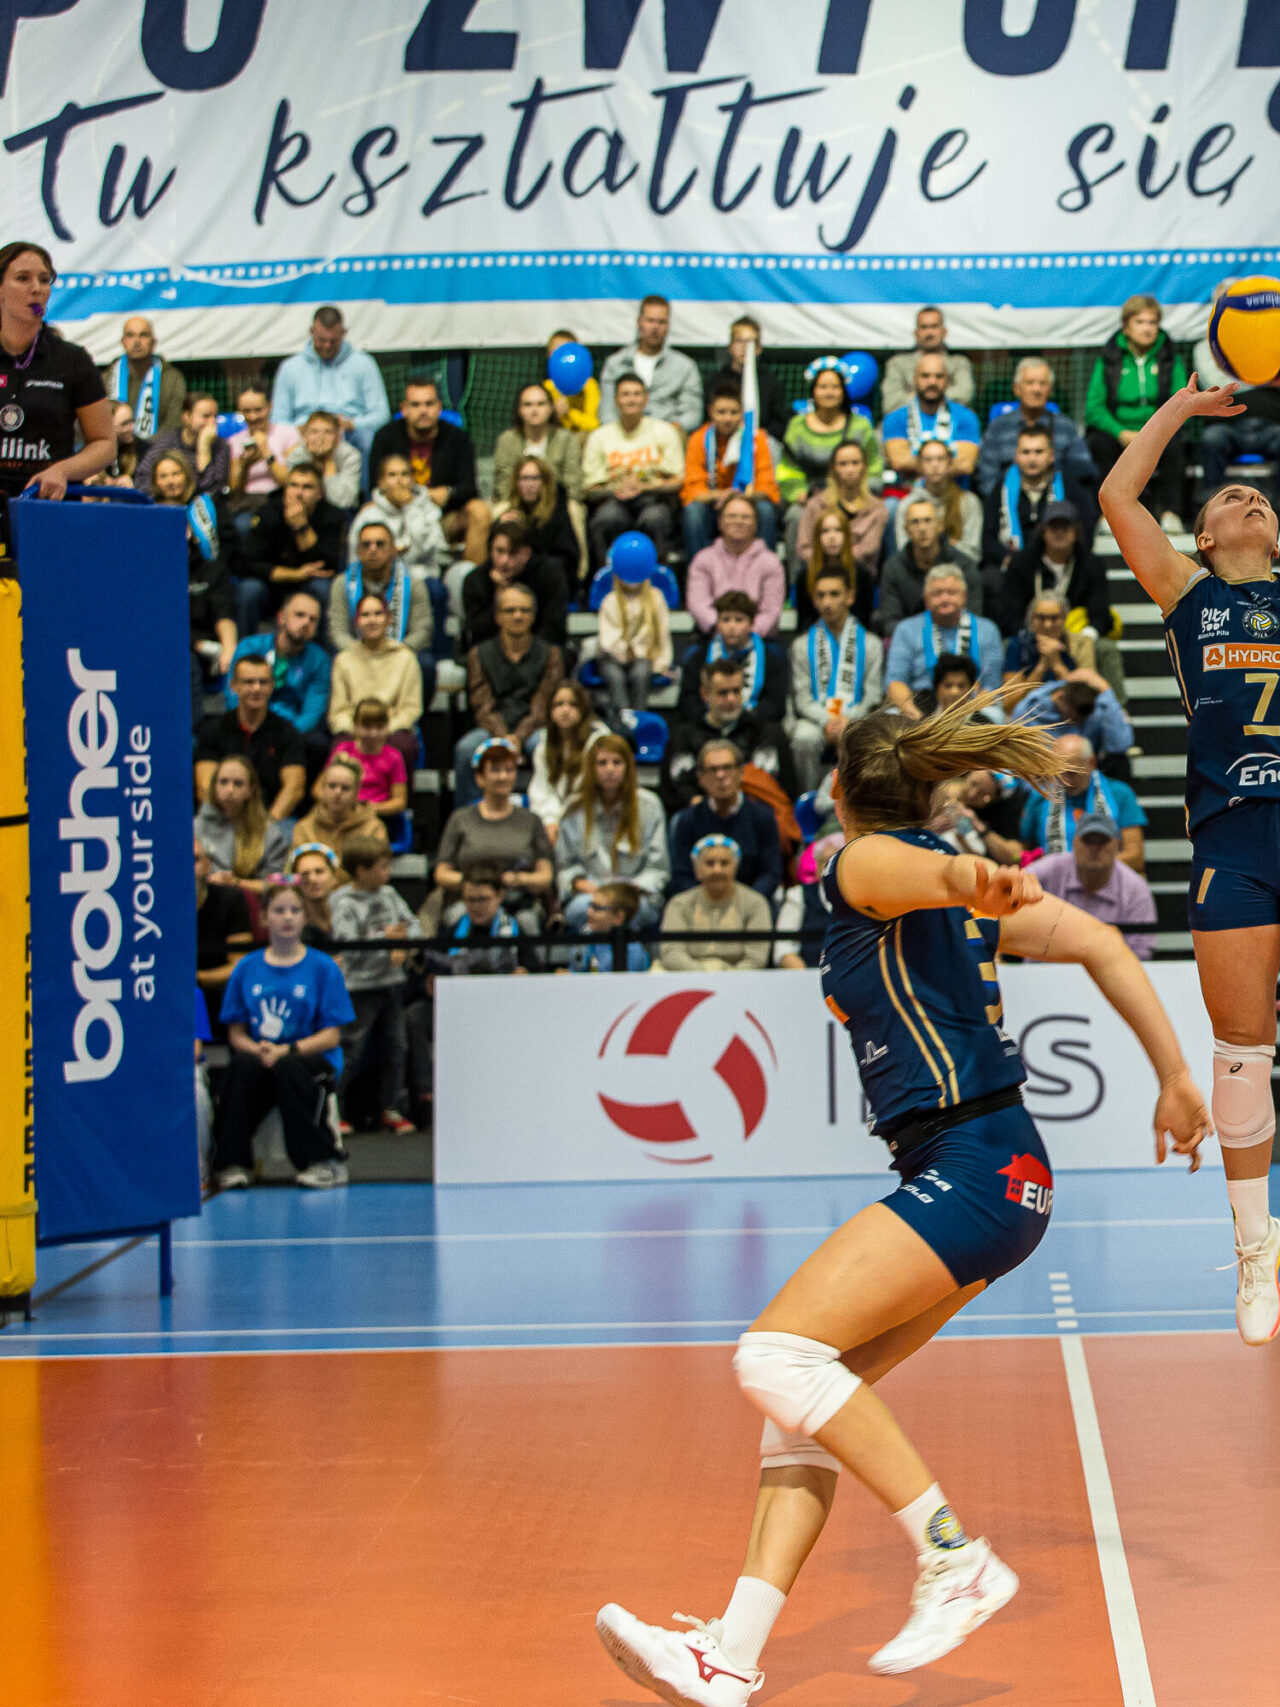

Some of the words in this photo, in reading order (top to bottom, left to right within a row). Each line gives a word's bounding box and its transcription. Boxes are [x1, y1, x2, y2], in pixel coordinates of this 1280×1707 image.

[3, 91, 178, 242] Tu
[253, 75, 988, 254] kształtuje
[1056, 103, 1254, 213] się
[1245, 673, 1280, 722] 7
[123, 724, 152, 822] side
[59, 648, 124, 1084] brother
[131, 829, 162, 942] your
[130, 953, 155, 1001] at
